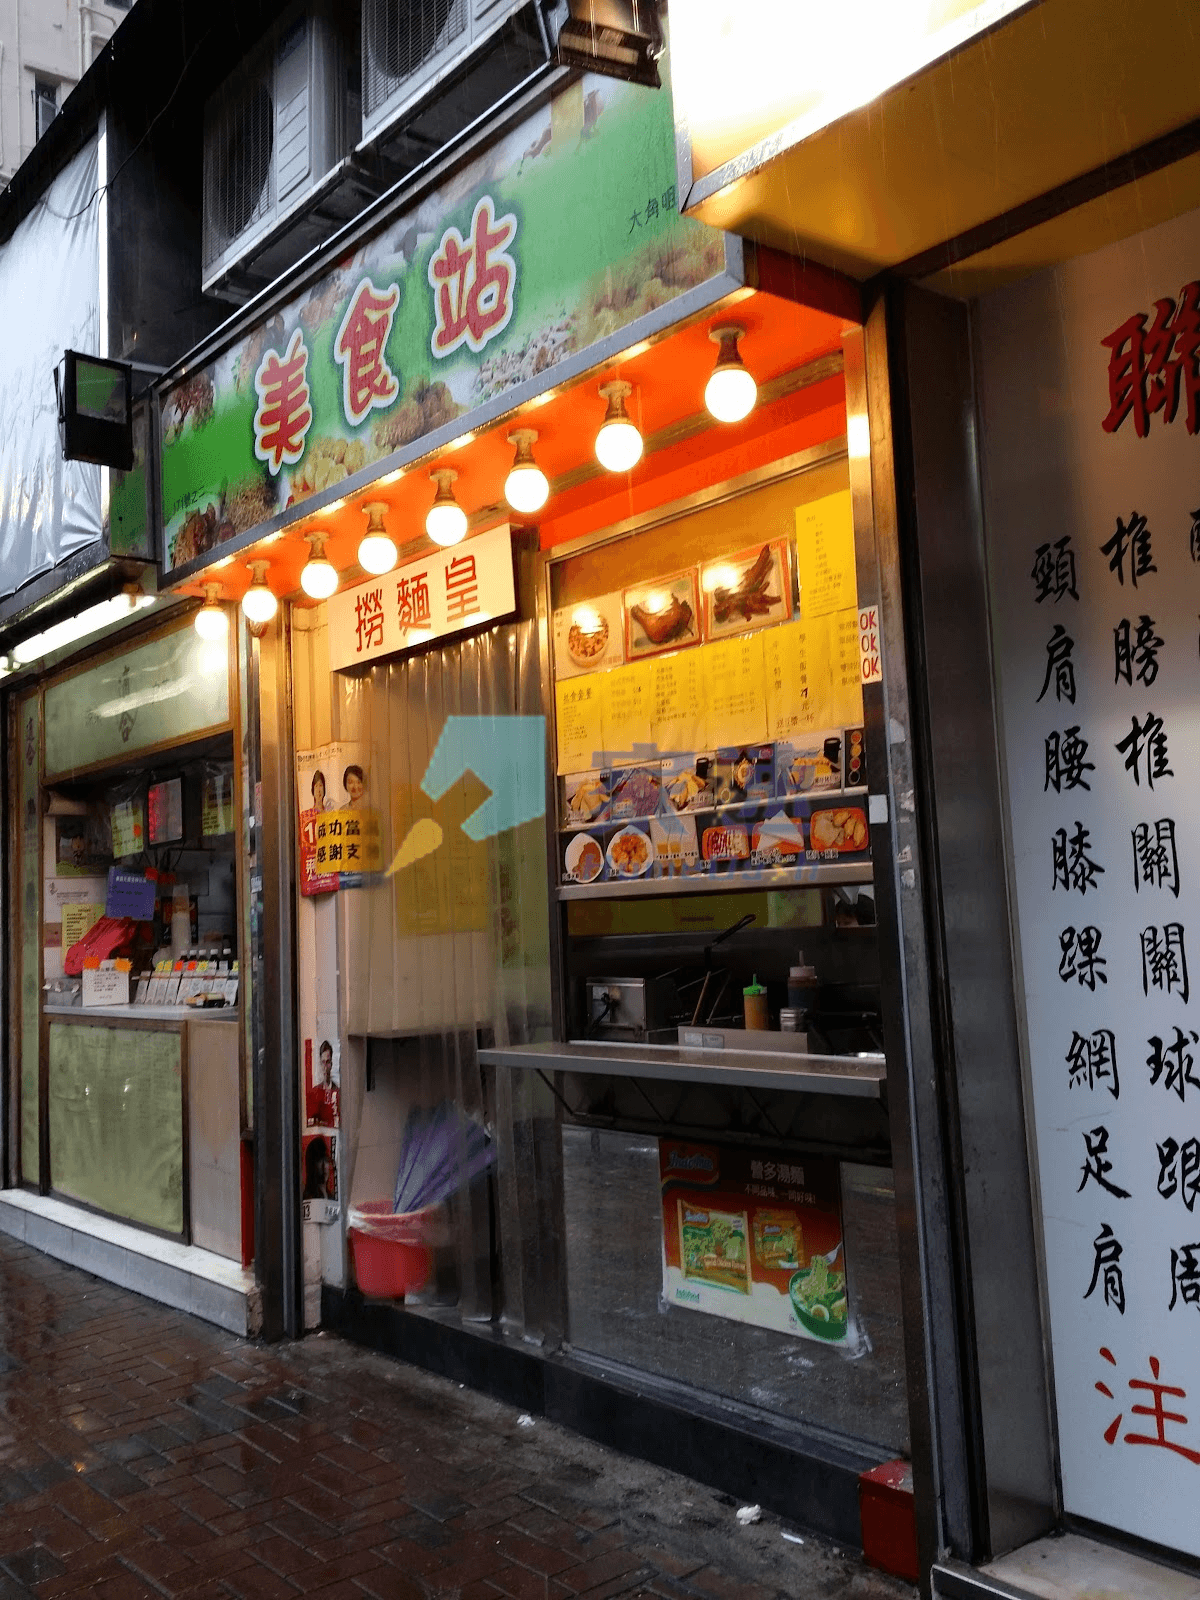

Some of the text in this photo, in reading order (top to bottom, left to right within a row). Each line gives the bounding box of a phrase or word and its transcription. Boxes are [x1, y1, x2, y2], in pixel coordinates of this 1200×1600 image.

[255, 196, 517, 475] 美食站
[355, 555, 480, 653] 撈麵皇
[1095, 1347, 1200, 1465] 注
